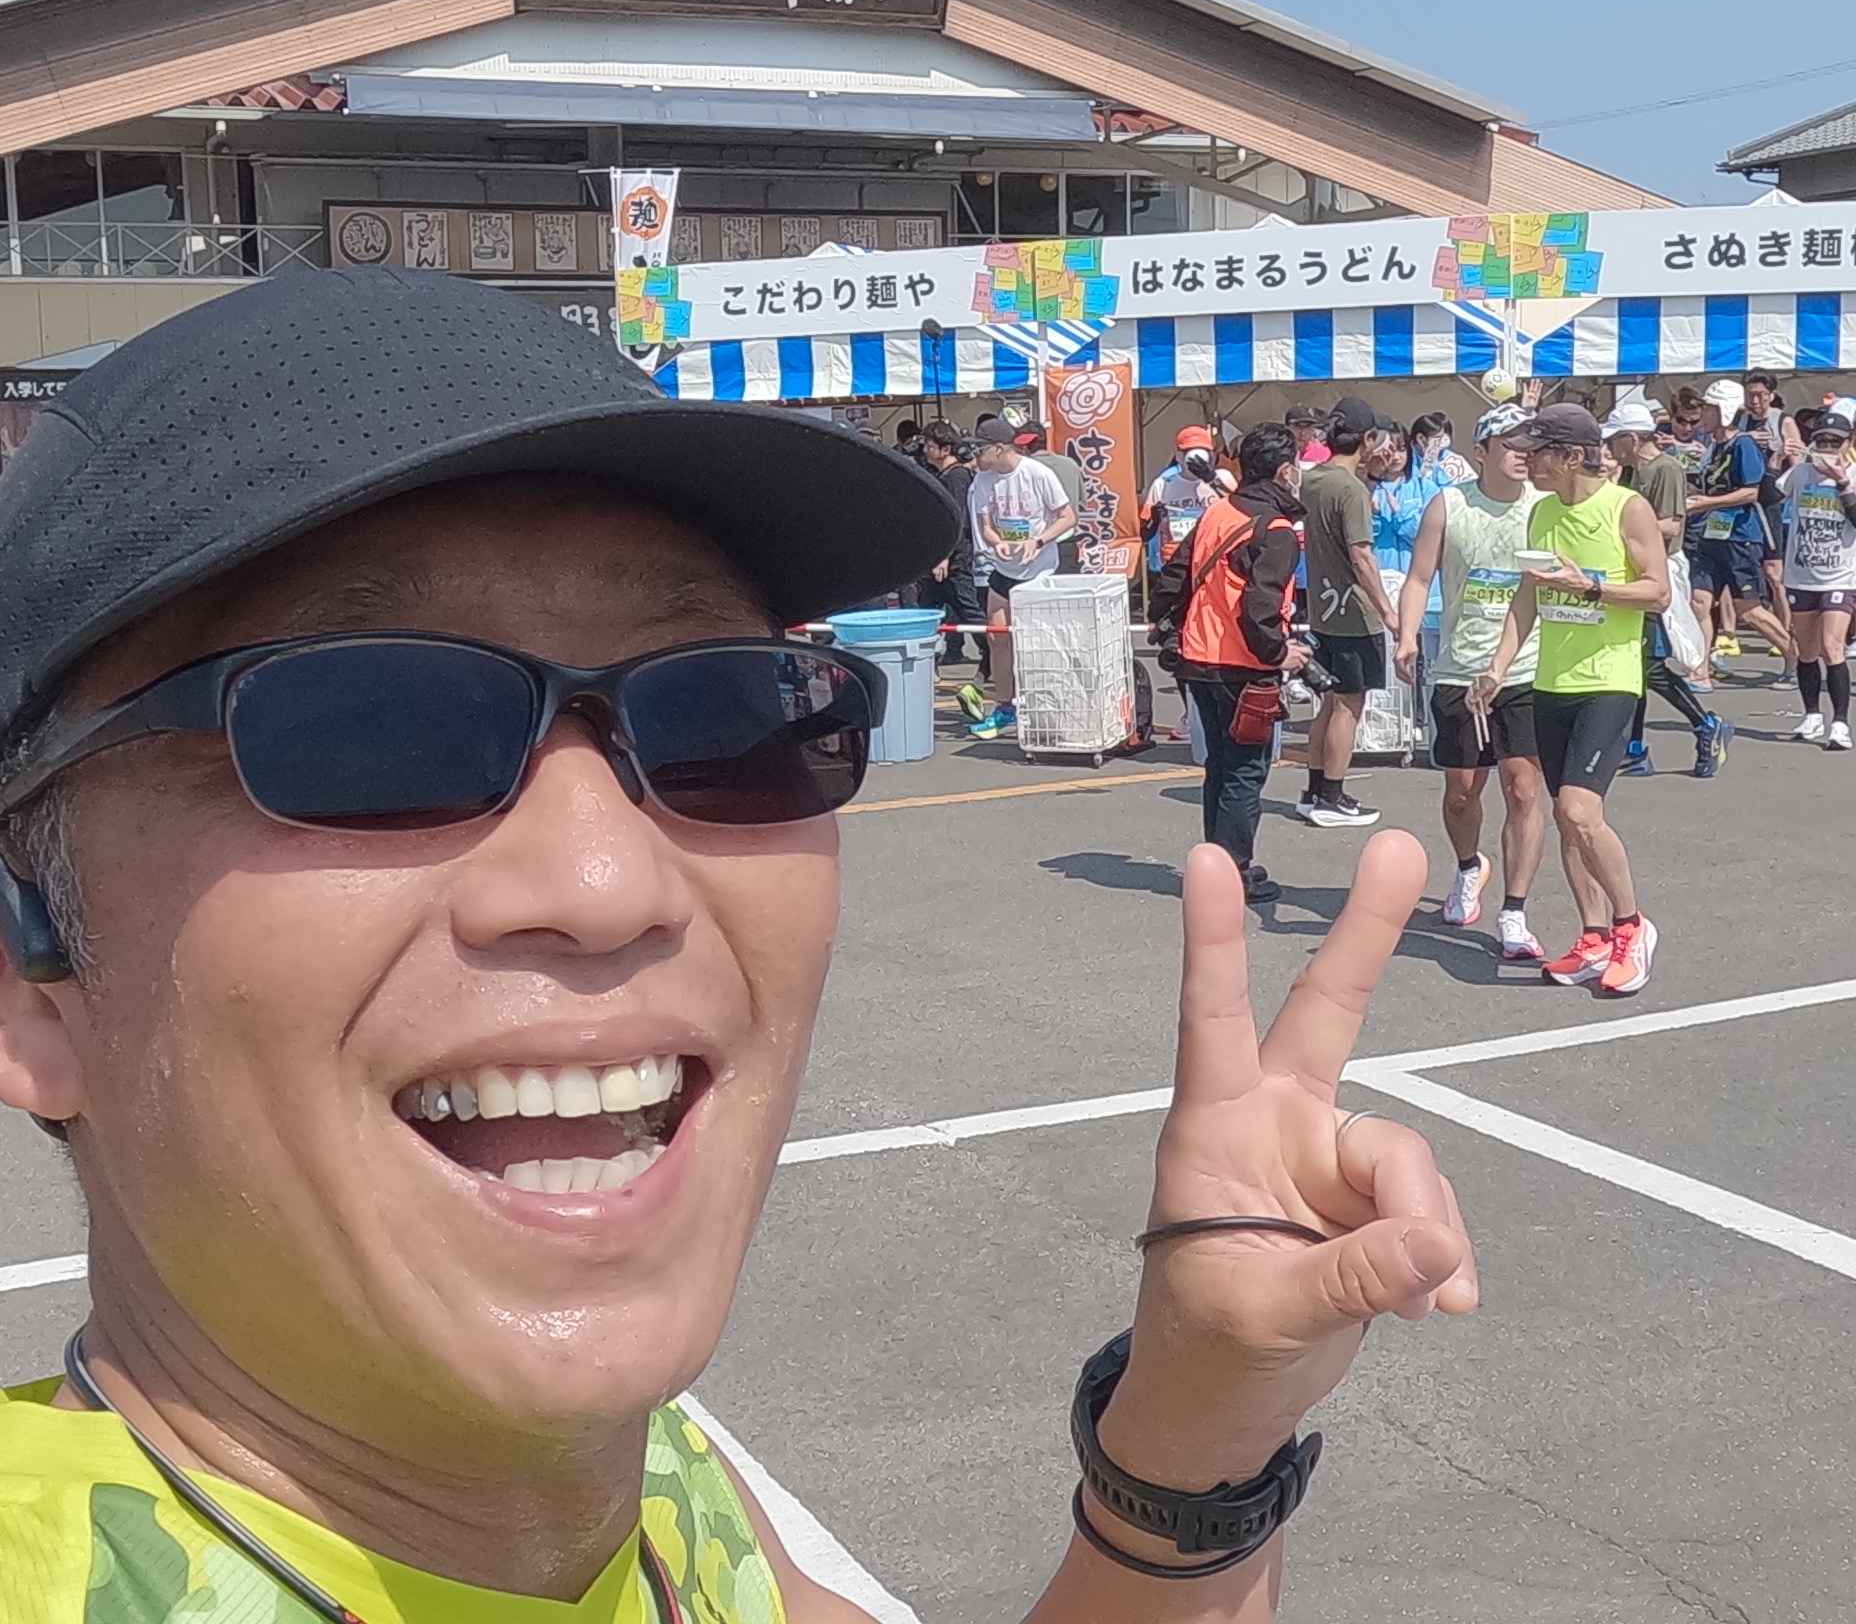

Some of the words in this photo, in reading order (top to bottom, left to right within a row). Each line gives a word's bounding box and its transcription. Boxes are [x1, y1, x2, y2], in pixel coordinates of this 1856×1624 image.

[721, 270, 936, 317] こだわり麺や
[1130, 242, 1419, 296] はなまるうどん
